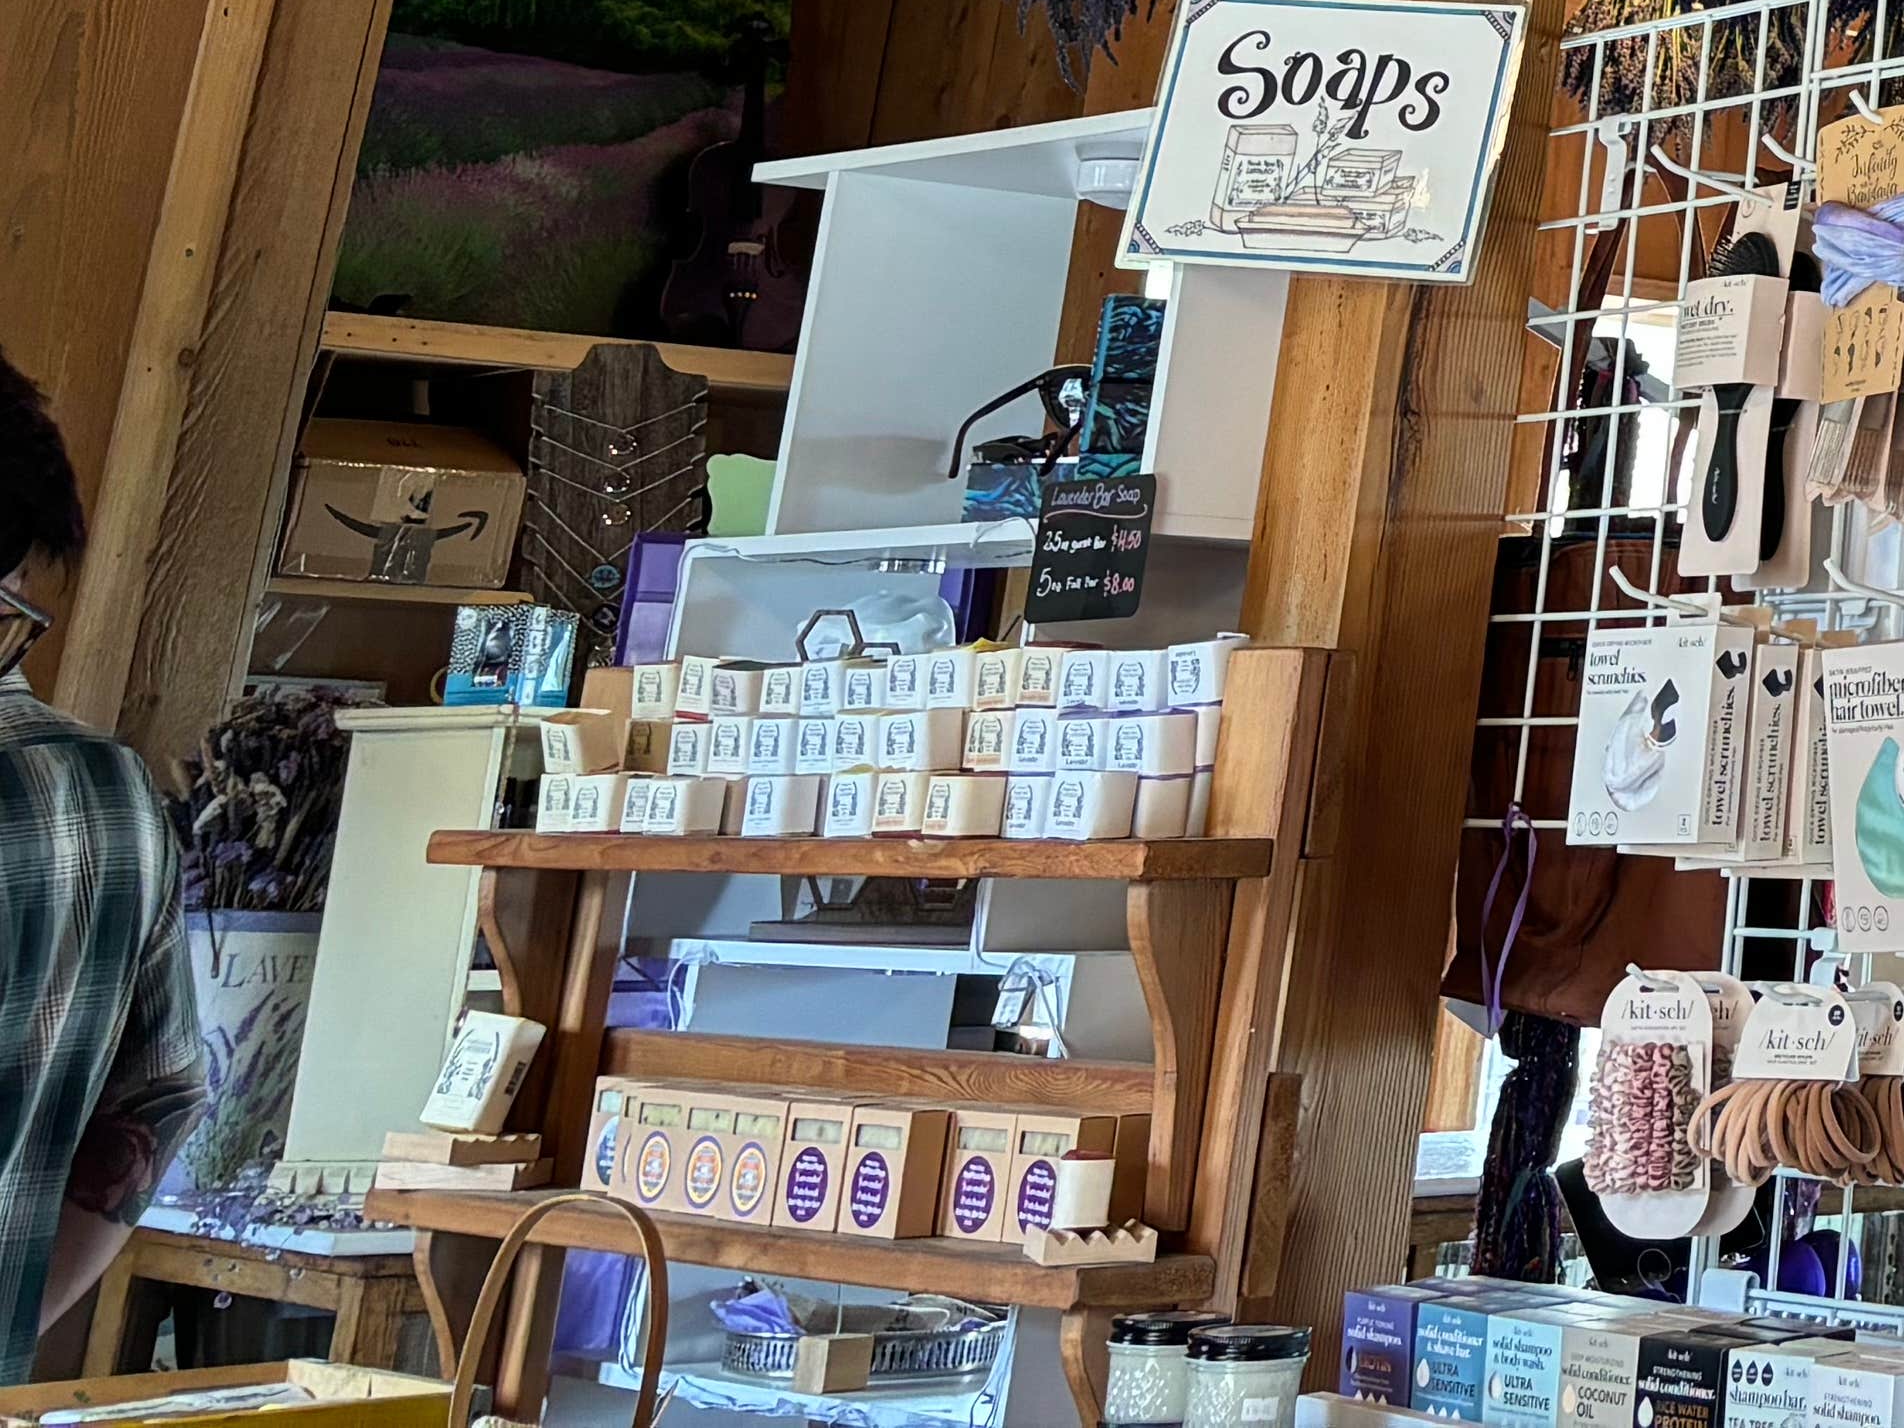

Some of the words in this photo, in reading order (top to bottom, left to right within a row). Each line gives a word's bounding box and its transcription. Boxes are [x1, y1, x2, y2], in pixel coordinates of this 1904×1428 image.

[1217, 30, 1450, 140] Soaps
[1051, 486, 1093, 507] Lavender
[1093, 482, 1115, 510] Bar
[1116, 484, 1141, 505] Soap
[1590, 648, 1621, 667] towel
[1831, 698, 1858, 722] hair
[1860, 694, 1904, 719] towel.
[1711, 780, 1727, 826] towel
[1760, 796, 1775, 842] towel
[1814, 801, 1827, 846] towel
[221, 952, 309, 987] LAVE
[1431, 1361, 1460, 1378] ULTRA
[1430, 1377, 1476, 1398] SENSITIVE
[1503, 1373, 1533, 1391] ULTRA
[1503, 1391, 1551, 1412] SENSITIVE
[1577, 1385, 1628, 1406] COCONUT
[1576, 1401, 1595, 1420] OIL
[1678, 1403, 1710, 1418] WATER
[1812, 1401, 1836, 1418] solid
